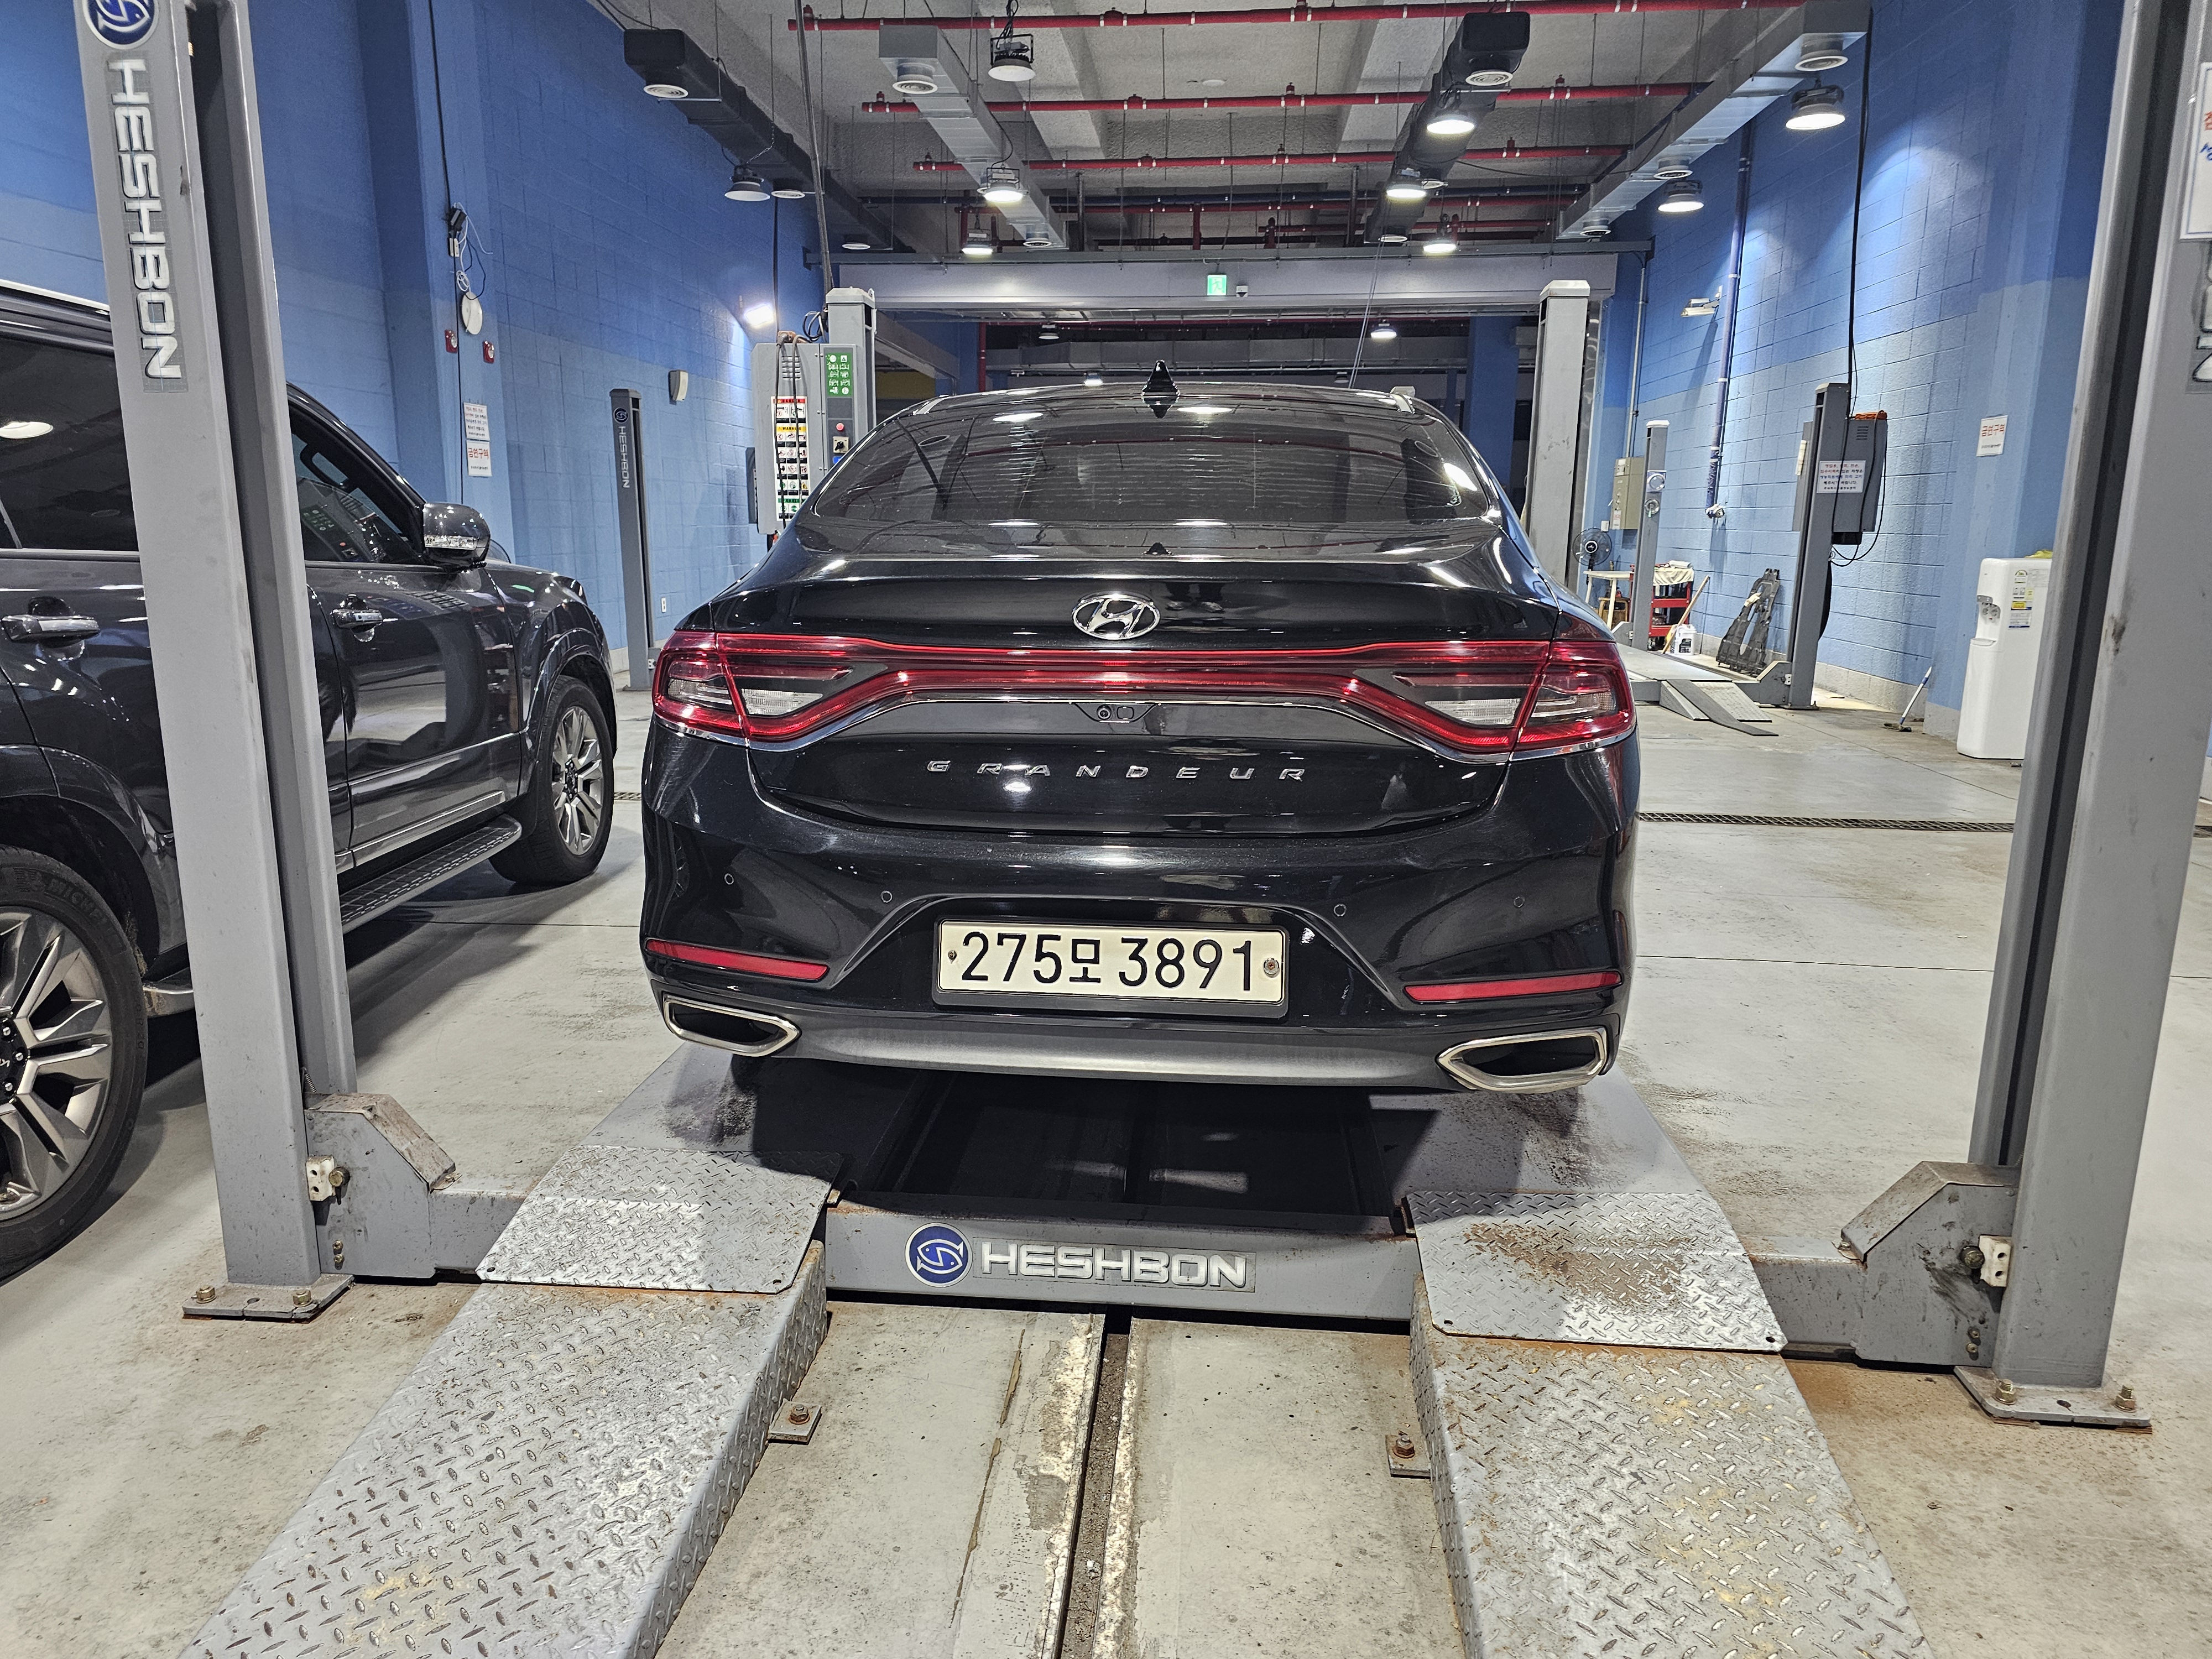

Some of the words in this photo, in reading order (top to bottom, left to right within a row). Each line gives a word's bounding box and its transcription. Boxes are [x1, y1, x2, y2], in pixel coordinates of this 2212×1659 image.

[107, 58, 182, 379] HESHBON
[468, 447, 489, 460] 금연구역
[1981, 424, 2005, 437] 금연구역
[618, 426, 630, 488] HESHBON
[926, 760, 1306, 782] GRANDEUR
[961, 931, 1101, 984] 275모
[1118, 937, 1251, 992] 3891
[980, 1241, 1247, 1289] HESHBON
